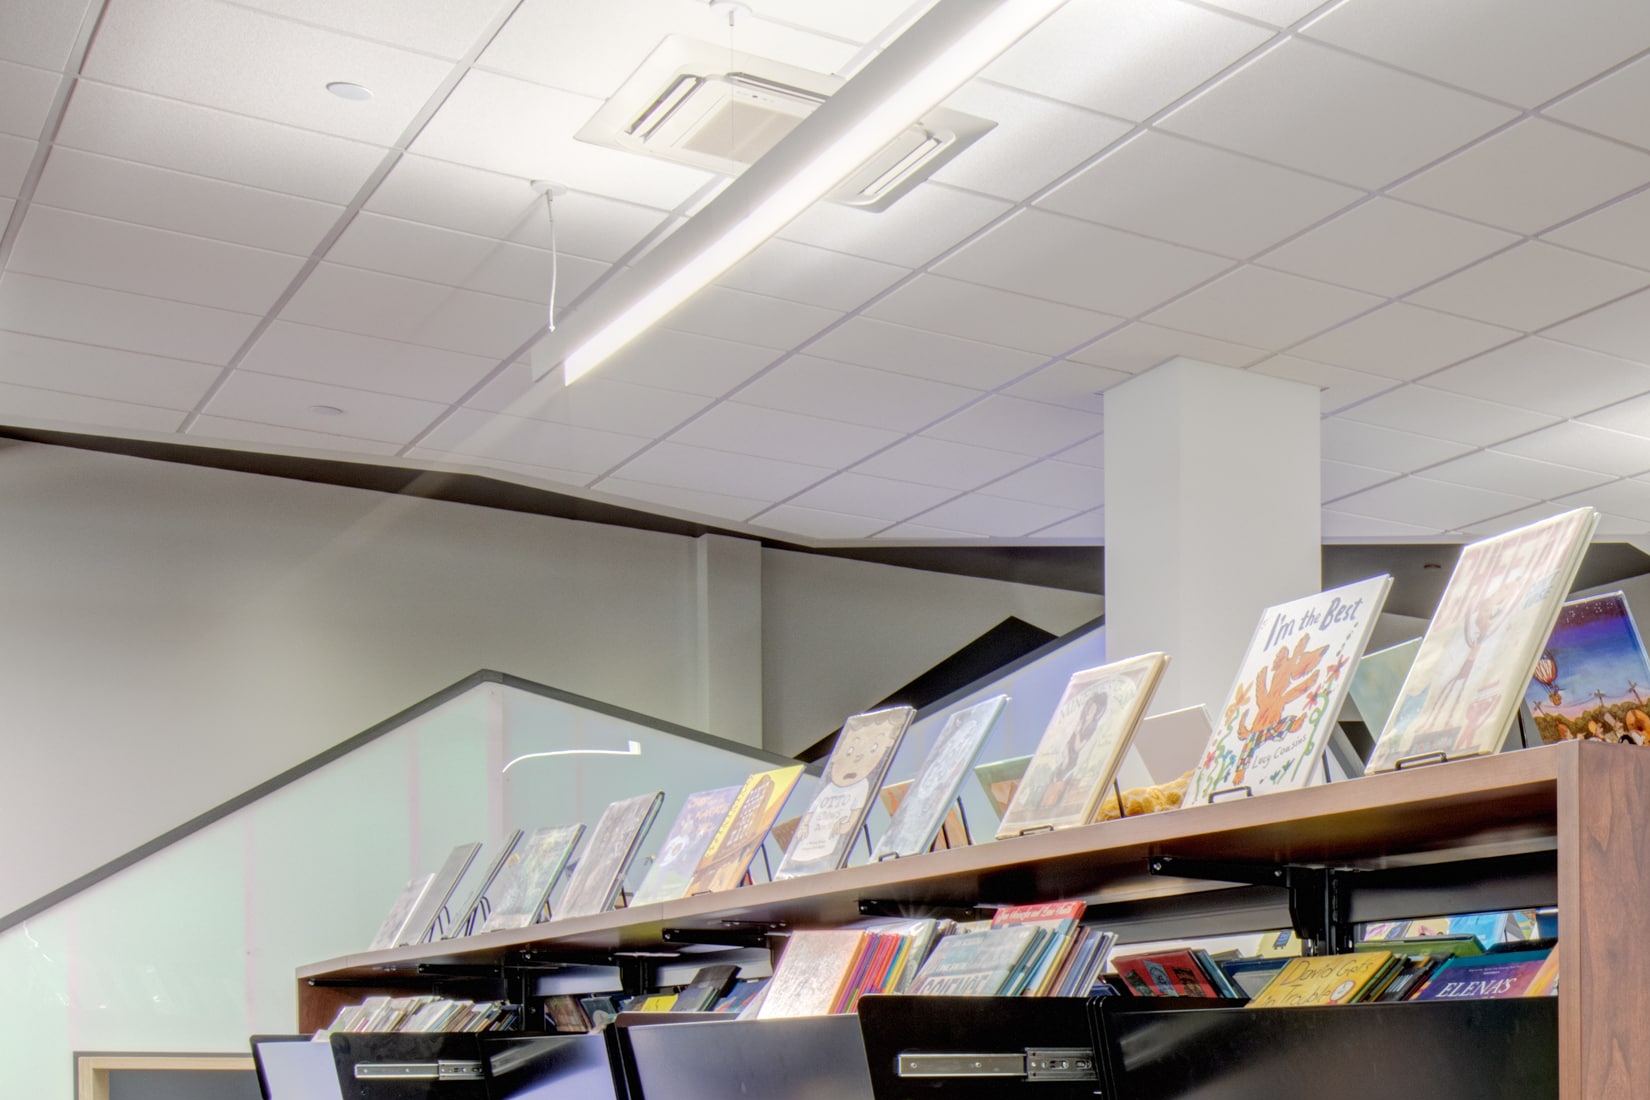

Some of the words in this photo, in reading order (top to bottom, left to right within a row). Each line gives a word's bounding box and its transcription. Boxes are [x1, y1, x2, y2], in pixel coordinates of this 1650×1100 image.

[1262, 611, 1295, 653] I'm
[1298, 609, 1322, 633] the
[1318, 597, 1363, 632] Best
[1280, 960, 1336, 986] David
[1435, 977, 1517, 998] ELENA'S
